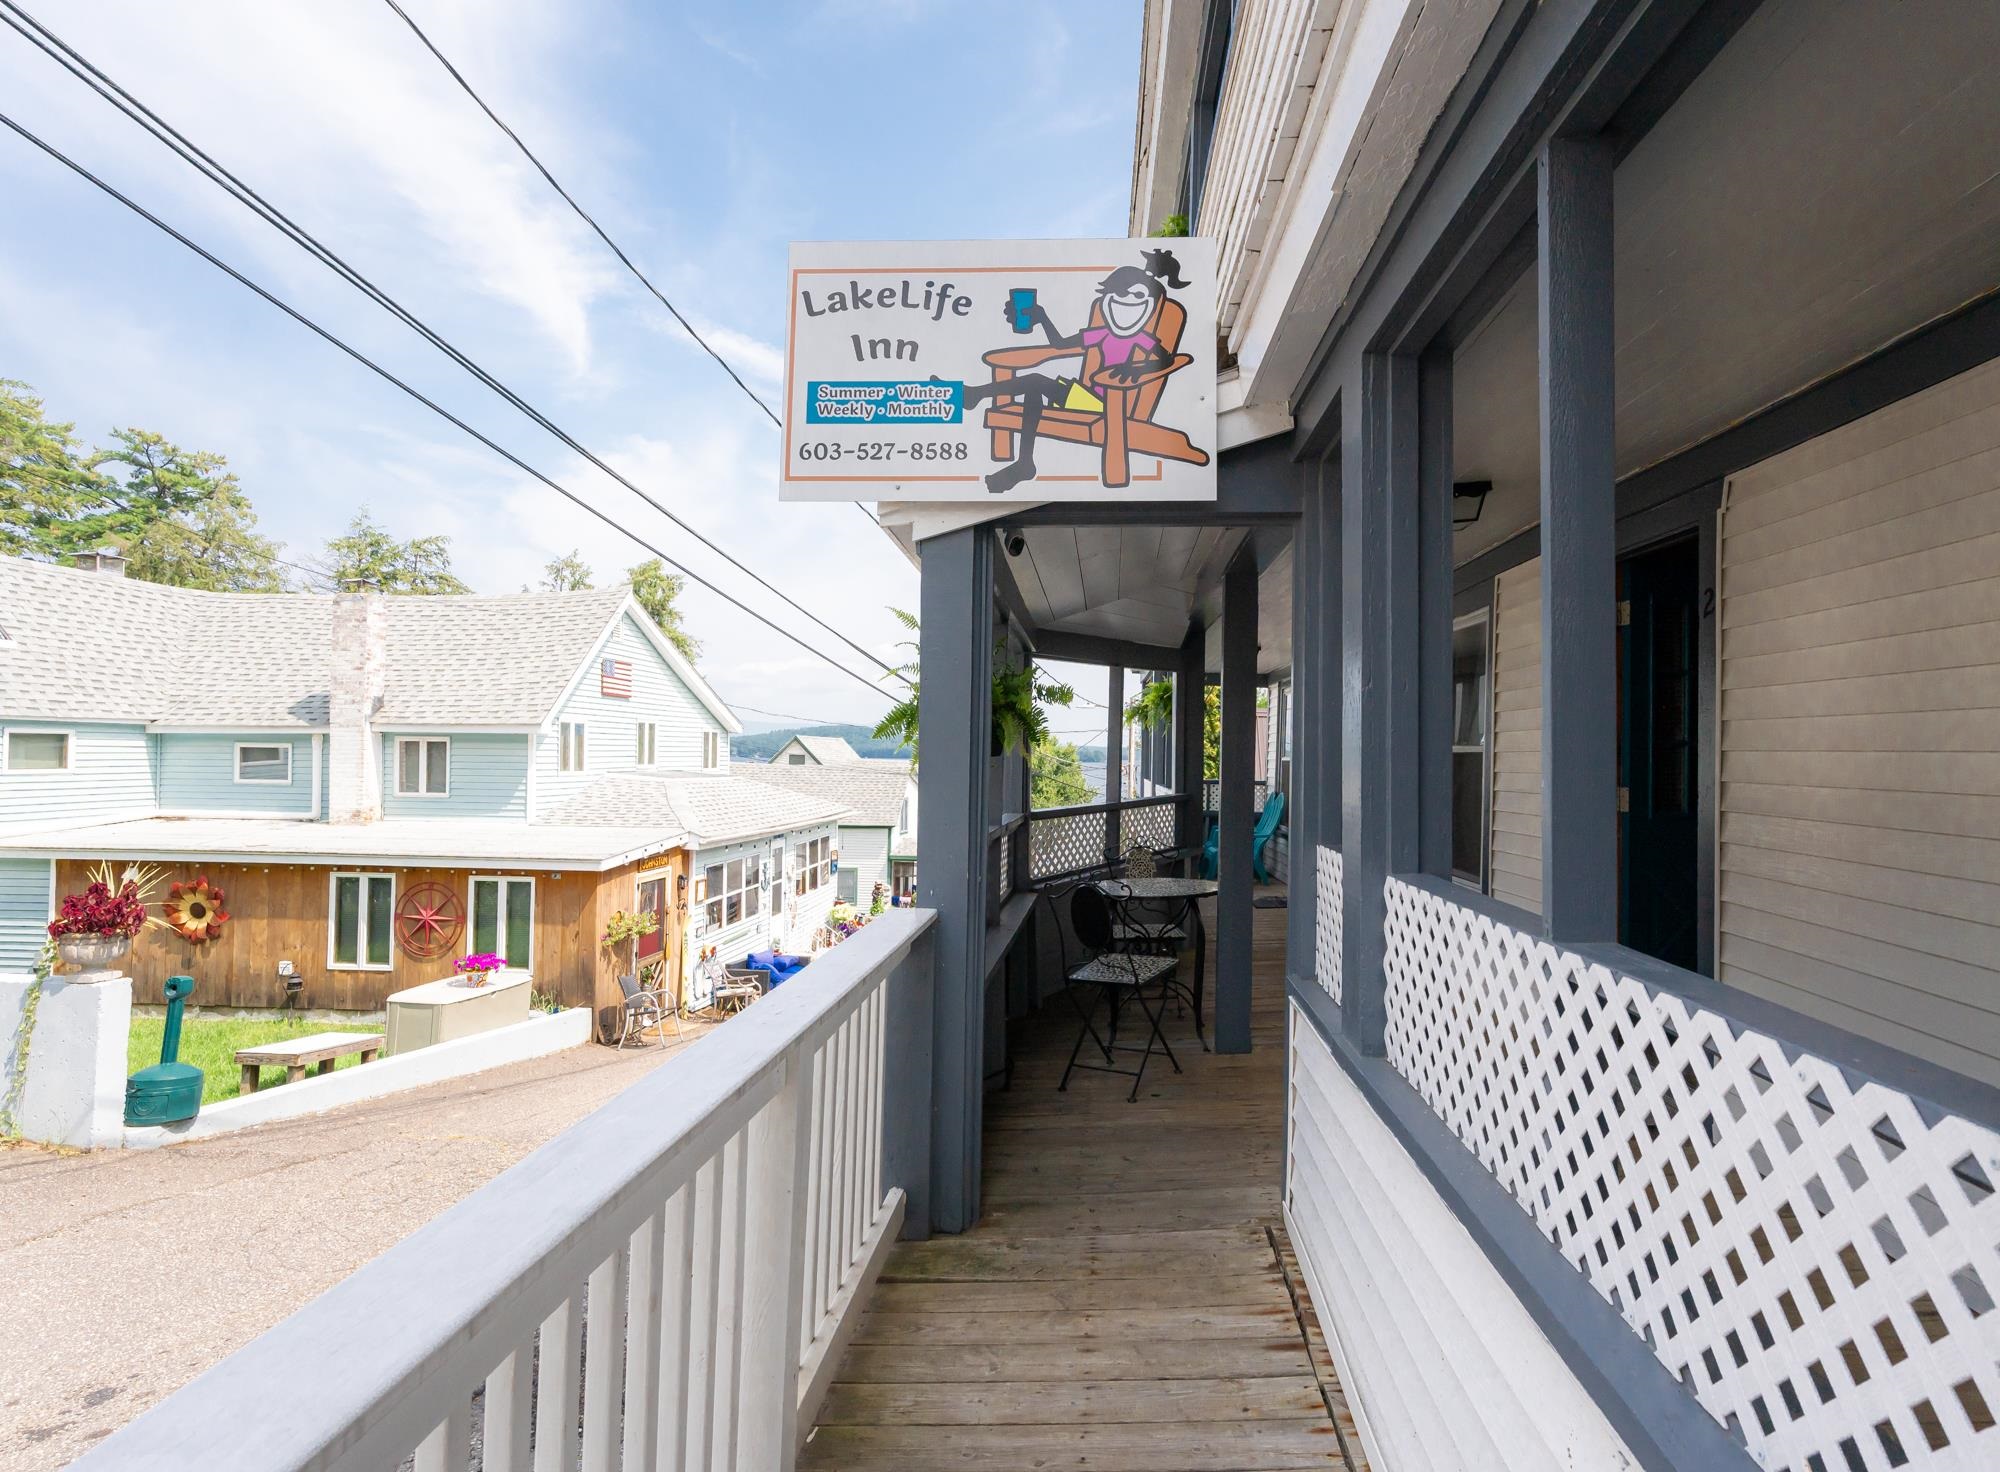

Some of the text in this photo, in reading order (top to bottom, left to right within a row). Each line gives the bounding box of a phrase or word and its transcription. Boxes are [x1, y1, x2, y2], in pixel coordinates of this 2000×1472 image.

[801, 280, 973, 321] LakeLife
[851, 334, 919, 362] Inn
[818, 385, 951, 399] Summer Winter
[817, 402, 952, 419] Weekly Monthly
[799, 441, 968, 461] 603-527-8588
[1703, 587, 1715, 618] 2
